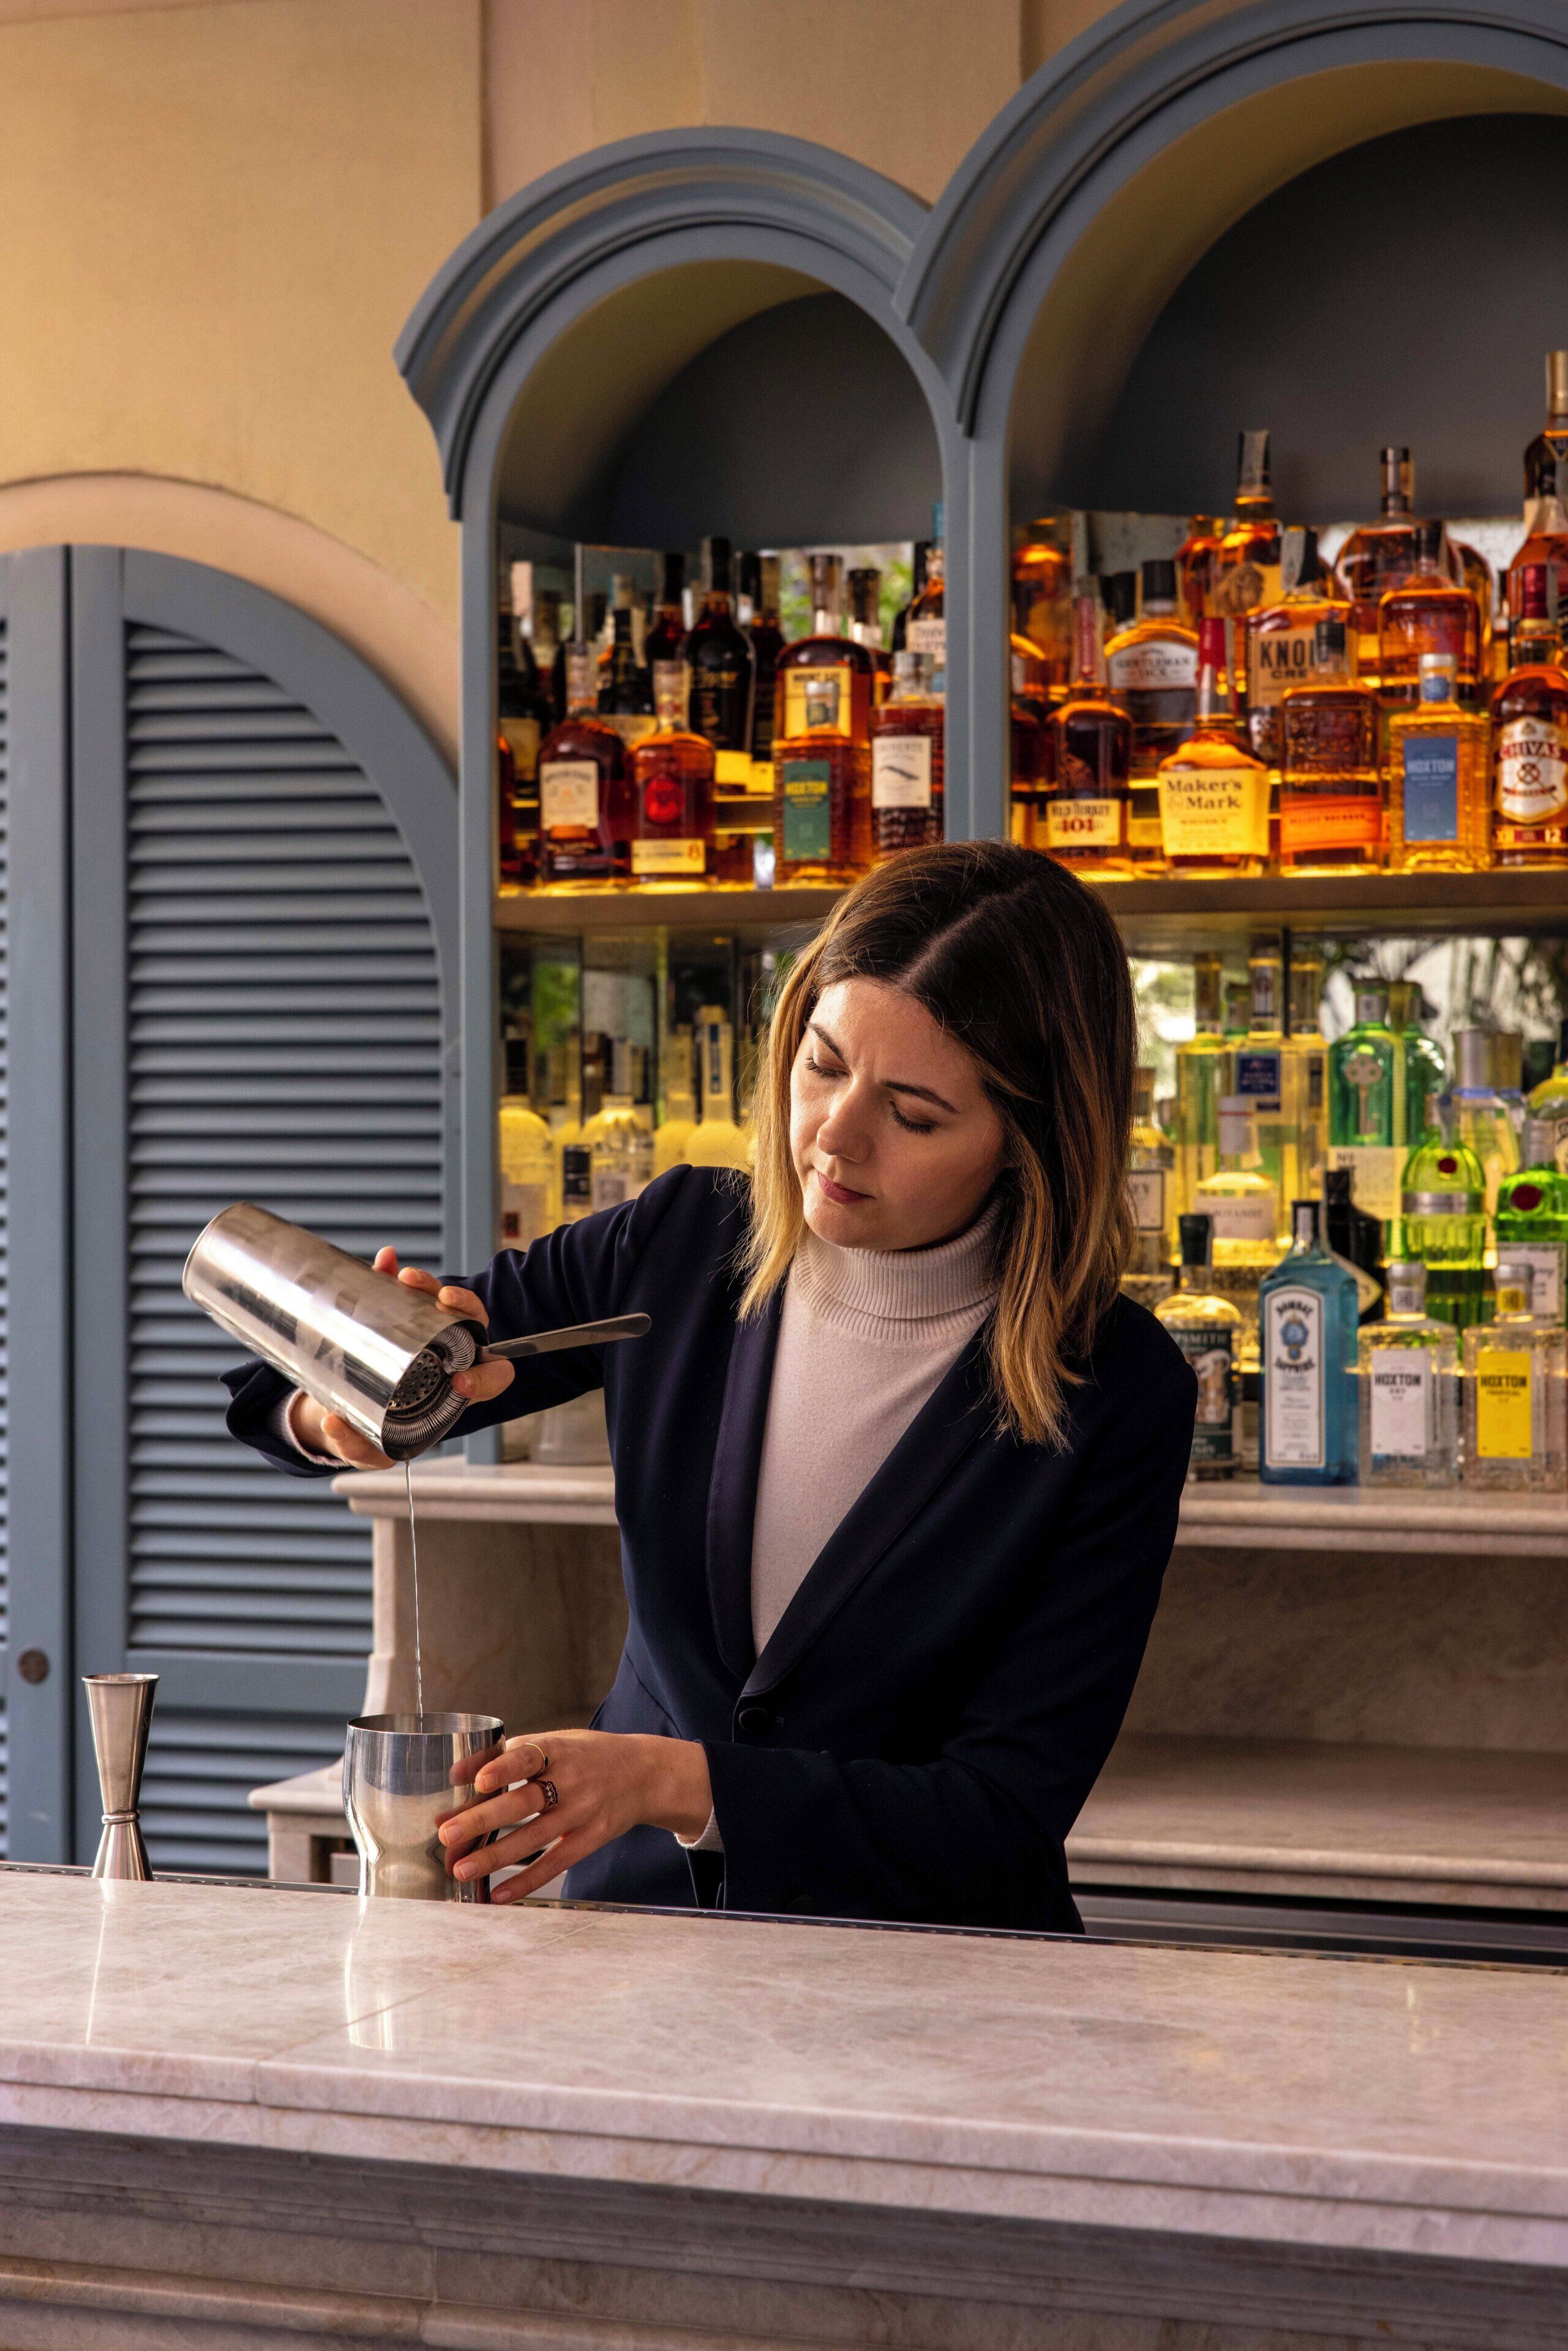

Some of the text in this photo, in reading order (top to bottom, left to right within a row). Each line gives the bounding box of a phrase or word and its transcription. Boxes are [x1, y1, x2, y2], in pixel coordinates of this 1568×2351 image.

[1116, 657, 1190, 669] GENTLEMAN
[1500, 742, 1561, 759] CHIVAS
[1407, 759, 1455, 773] HOXTON
[1167, 779, 1242, 792] Maker's
[1073, 802, 1110, 817] TURKEY
[1187, 796, 1242, 809] Mark
[1062, 817, 1093, 833] 101
[1544, 828, 1562, 843] 12
[1276, 1301, 1313, 1316] BOMBAY
[1375, 1373, 1421, 1386] HOXTON
[1480, 1374, 1527, 1388] HOXTON
